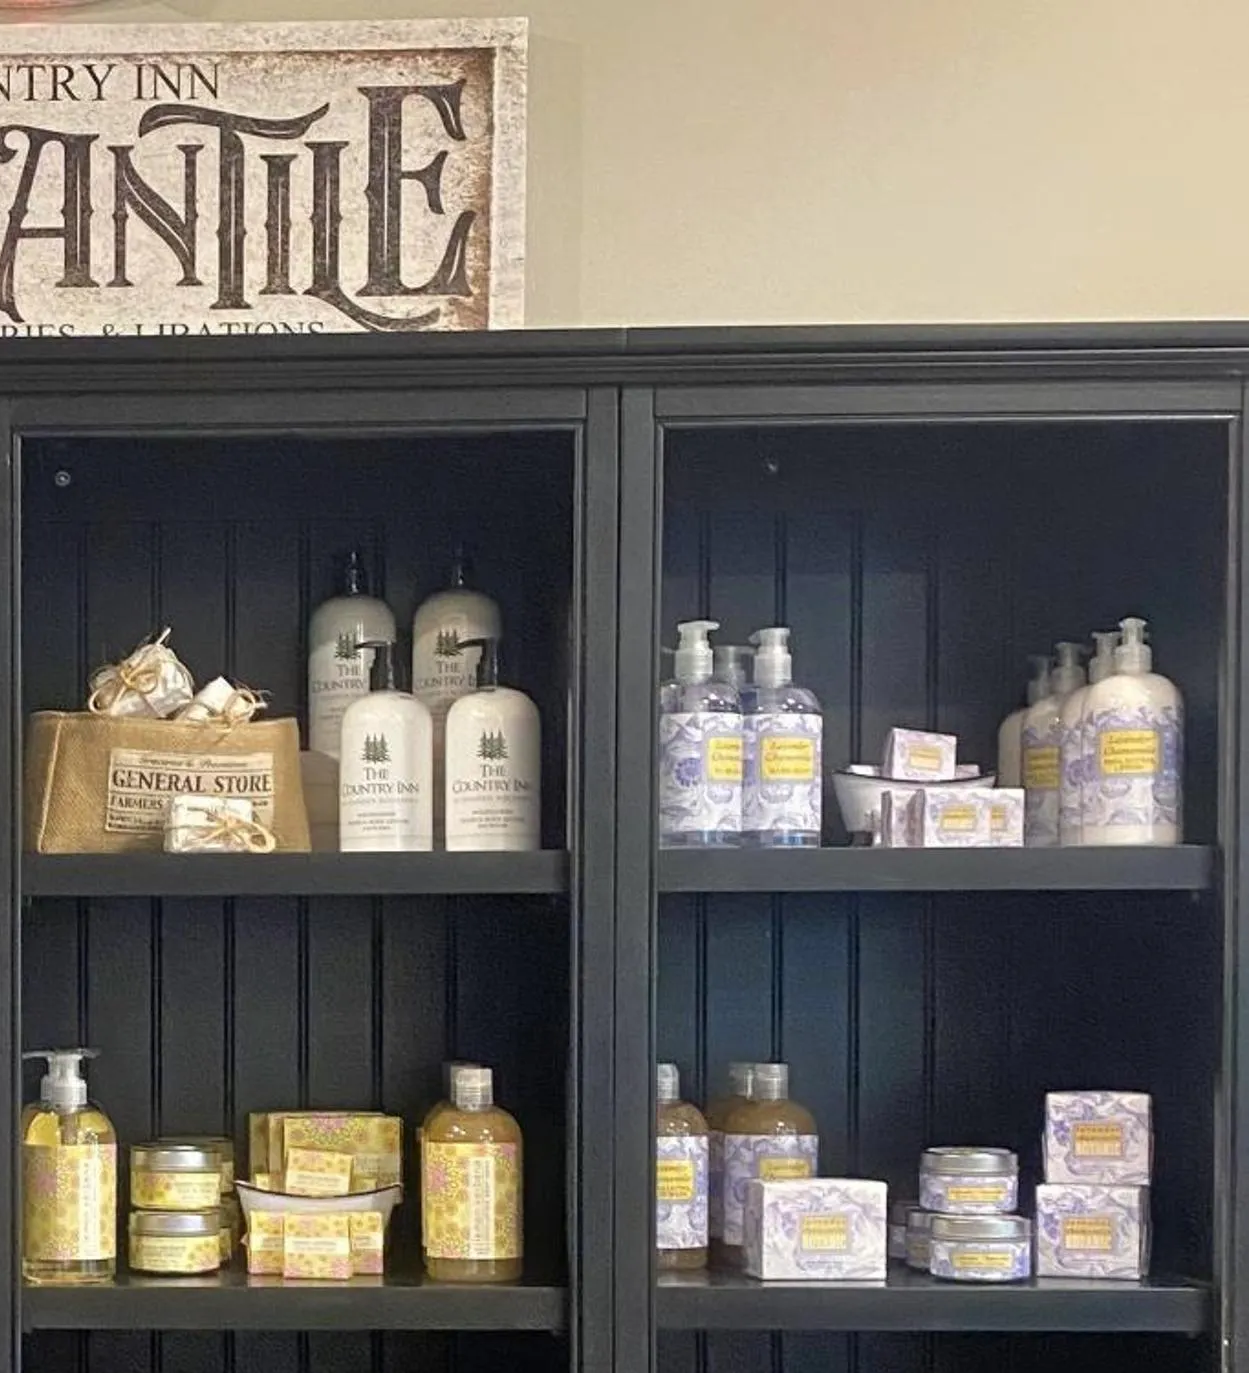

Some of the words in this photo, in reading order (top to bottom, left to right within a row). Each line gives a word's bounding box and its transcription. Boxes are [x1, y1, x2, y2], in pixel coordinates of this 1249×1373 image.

[134, 62, 221, 101] INN
[363, 767, 389, 780] THE
[480, 764, 506, 778] THE
[112, 768, 206, 793] GENERAL
[213, 773, 272, 794] STORE
[342, 783, 394, 797] COUNTRY
[397, 780, 421, 794] INN
[452, 779, 512, 794] COUNTRY
[109, 794, 163, 810] FARMERS
